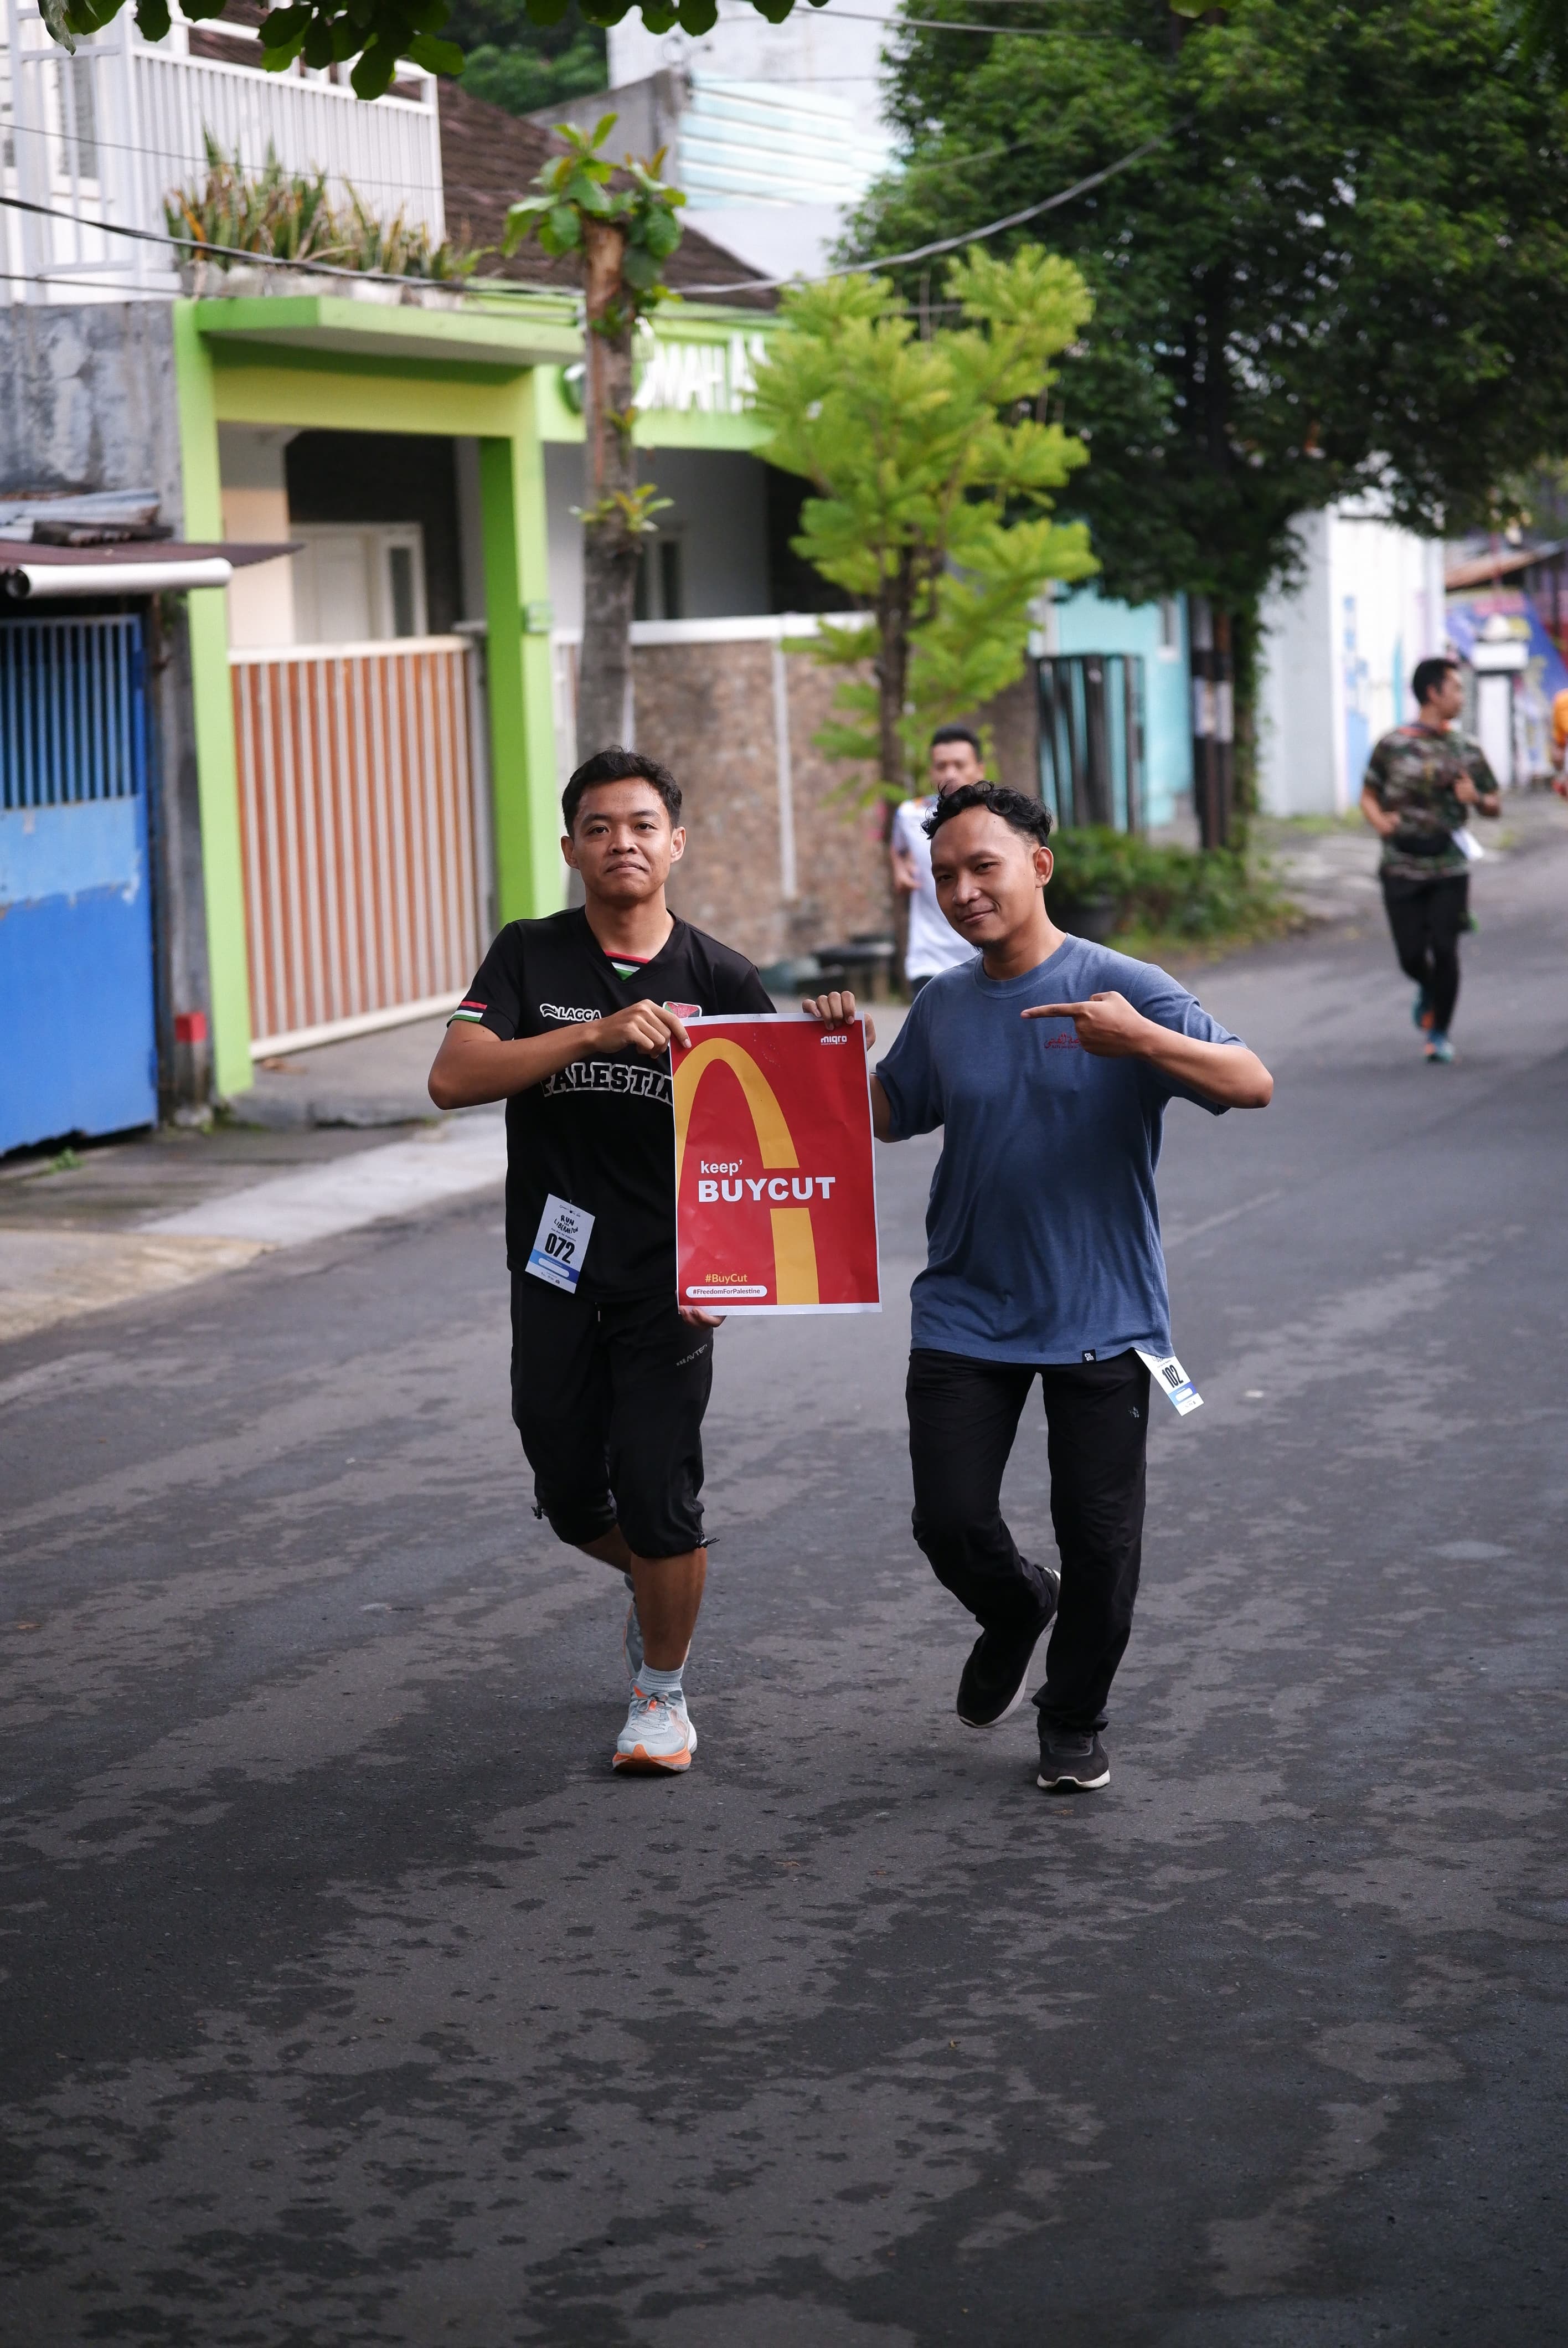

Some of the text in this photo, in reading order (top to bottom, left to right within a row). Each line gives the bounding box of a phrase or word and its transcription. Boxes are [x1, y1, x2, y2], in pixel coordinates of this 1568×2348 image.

[558, 1007, 602, 1022] LAGGA
[698, 1177, 835, 1202] BUYCUT
[554, 1218, 578, 1234] LIBERATION
[561, 1215, 574, 1226] RUN
[545, 1233, 575, 1264] 072
[705, 1274, 747, 1284] #BuyCut
[1162, 1364, 1184, 1388] 102
